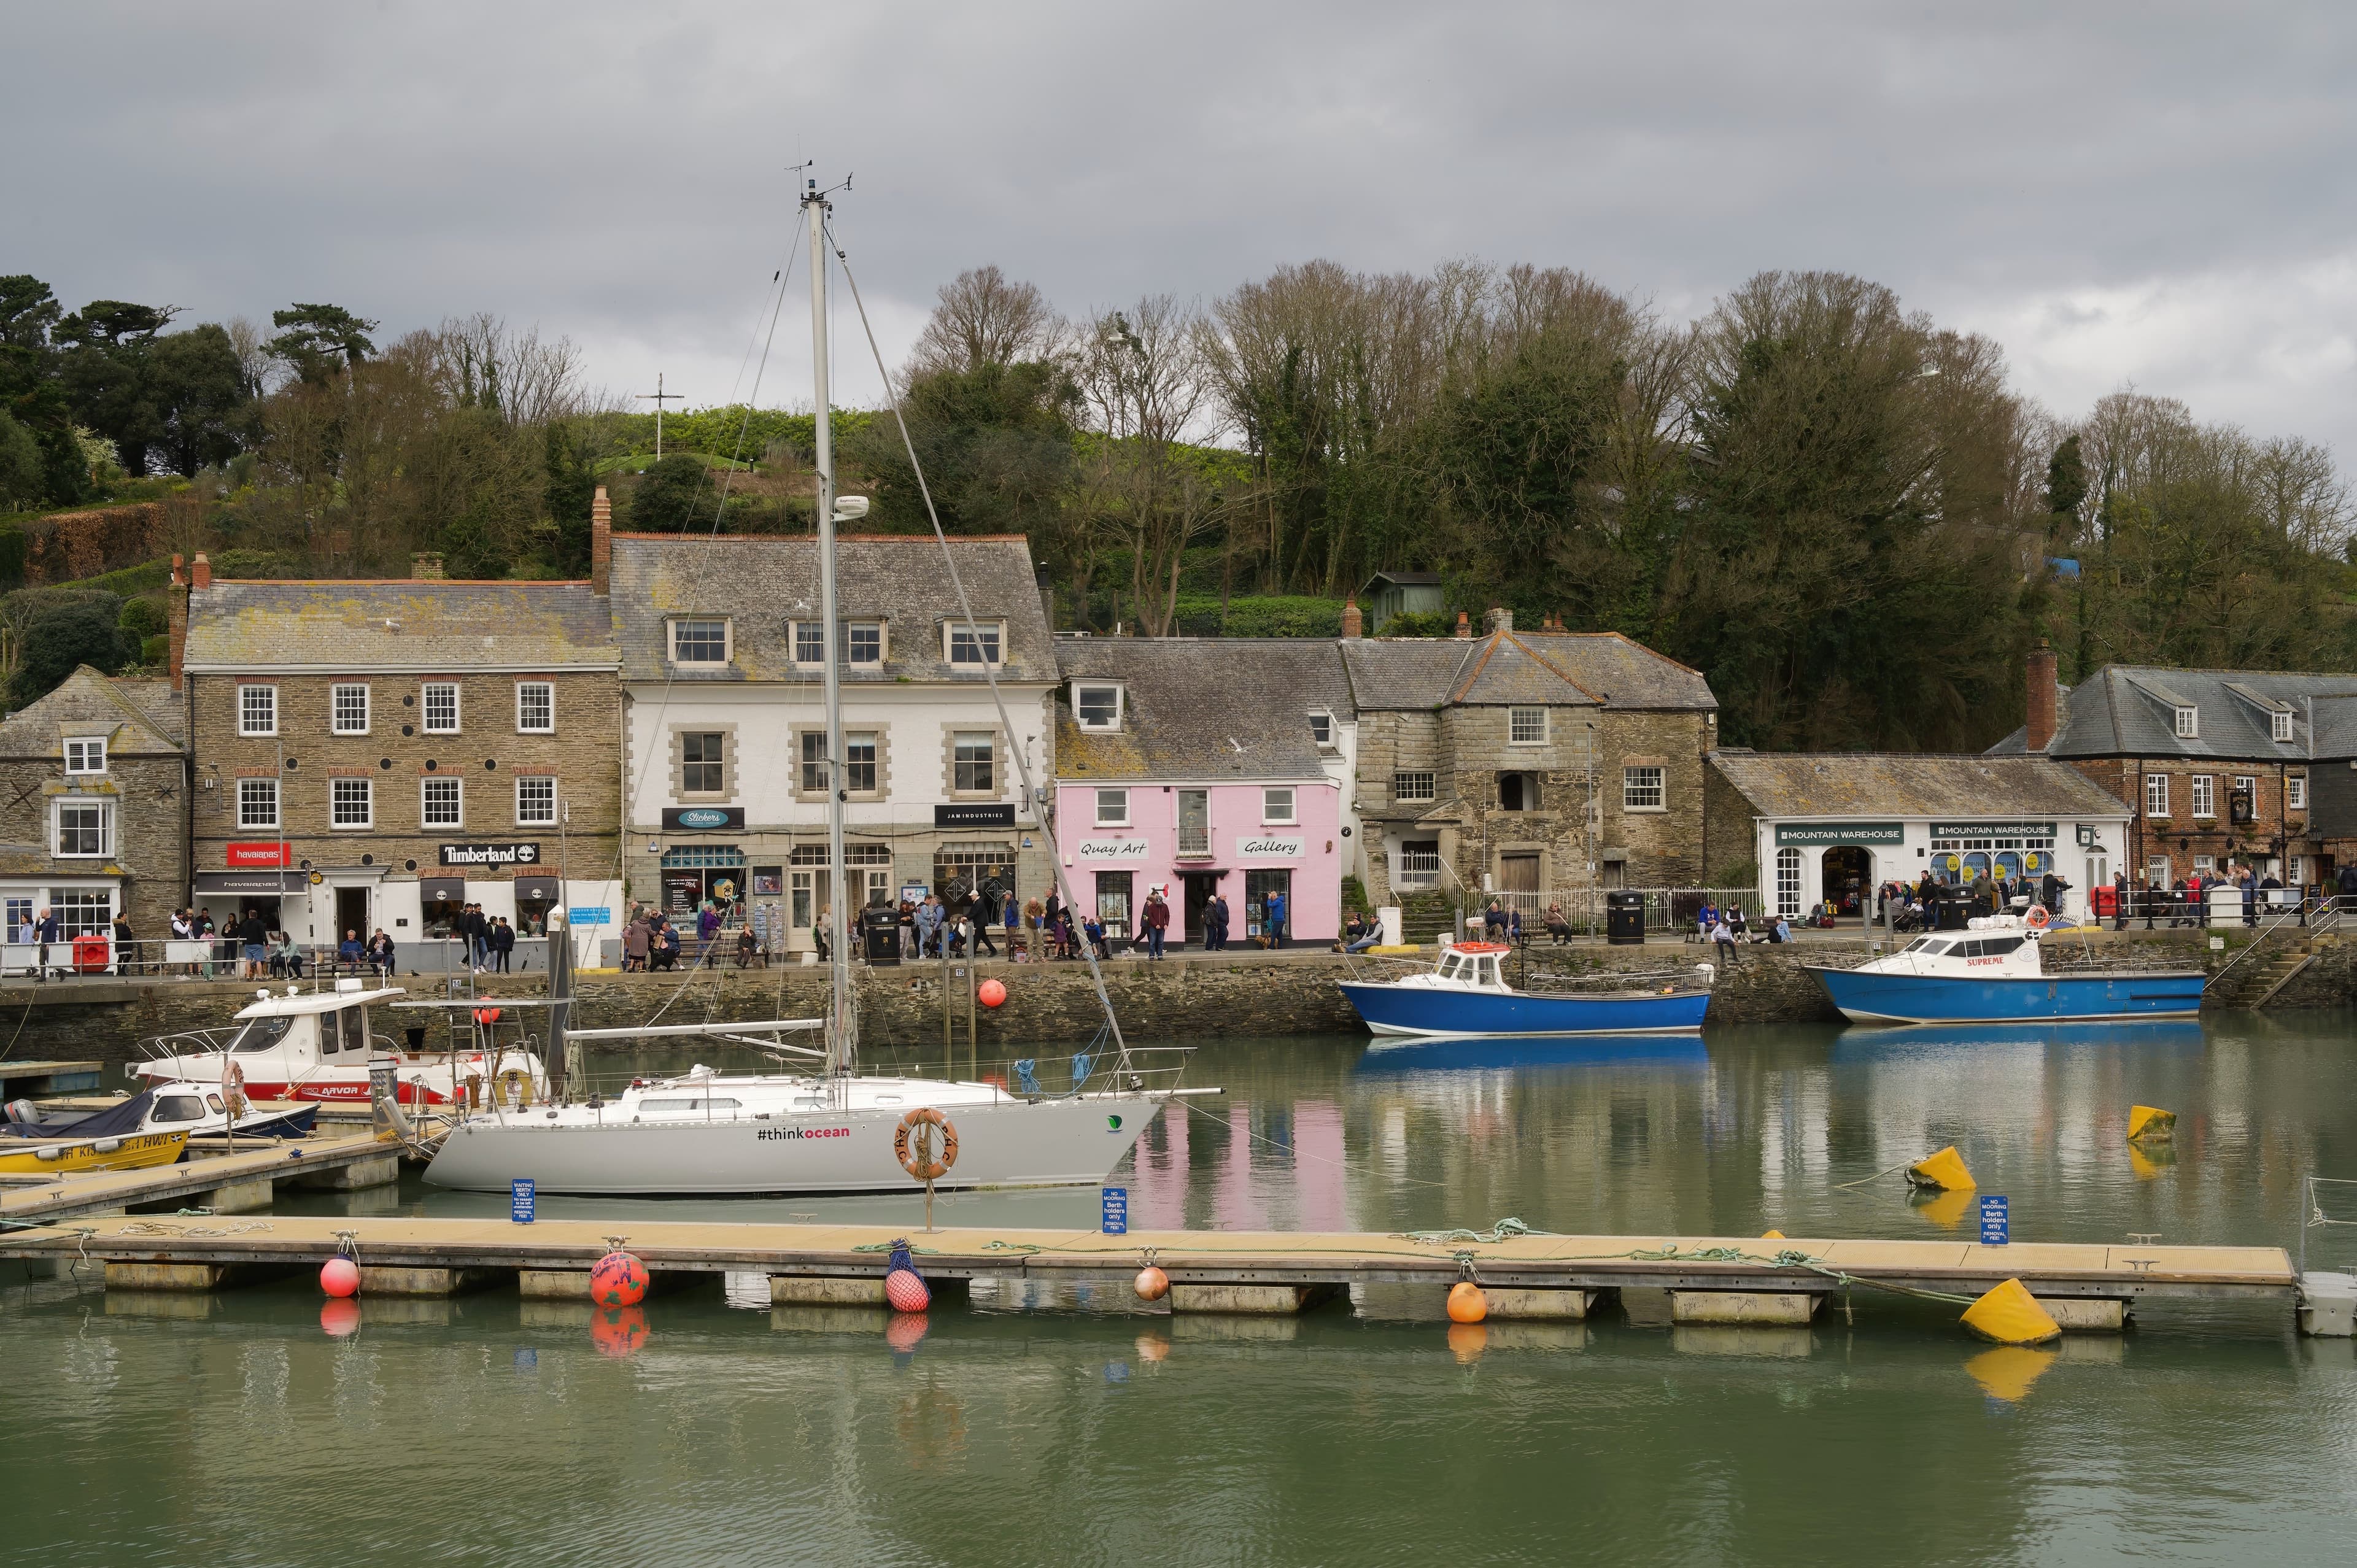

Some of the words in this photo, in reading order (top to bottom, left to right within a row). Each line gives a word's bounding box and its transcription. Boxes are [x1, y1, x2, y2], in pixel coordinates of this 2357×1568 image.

[687, 812, 721, 822] Slickers
[444, 846, 516, 863] Timberland
[1081, 844, 1118, 856] Quay
[1121, 843, 1147, 854] Art
[1244, 841, 1297, 855] Gallery
[1967, 957, 2005, 967] SUPREME
[322, 1087, 358, 1095] ARVOR
[757, 1126, 850, 1140] #thinkocean
